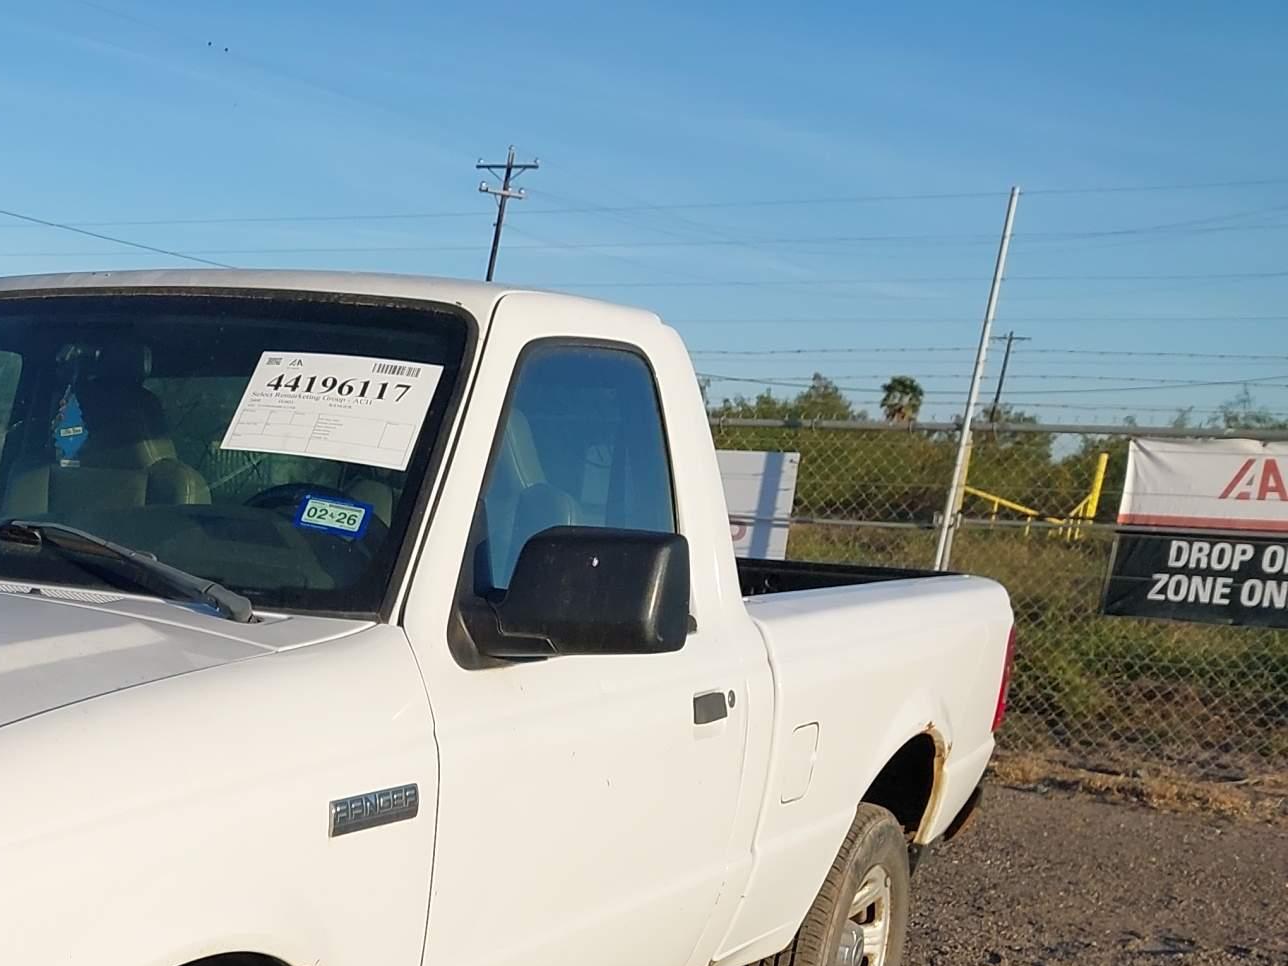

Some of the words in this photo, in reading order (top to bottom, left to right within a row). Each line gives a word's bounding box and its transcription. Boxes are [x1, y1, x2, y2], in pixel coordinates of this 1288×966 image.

[252, 391, 273, 399] Select
[275, 391, 321, 402] Remarketing
[322, 394, 346, 404] Group
[266, 373, 412, 403] 44196117
[306, 506, 328, 520] 02
[335, 512, 358, 526] 26
[1167, 540, 1255, 571] DROP
[1261, 544, 1288, 574] O
[1147, 573, 1233, 605] ZONE
[335, 788, 416, 823] RANGER
